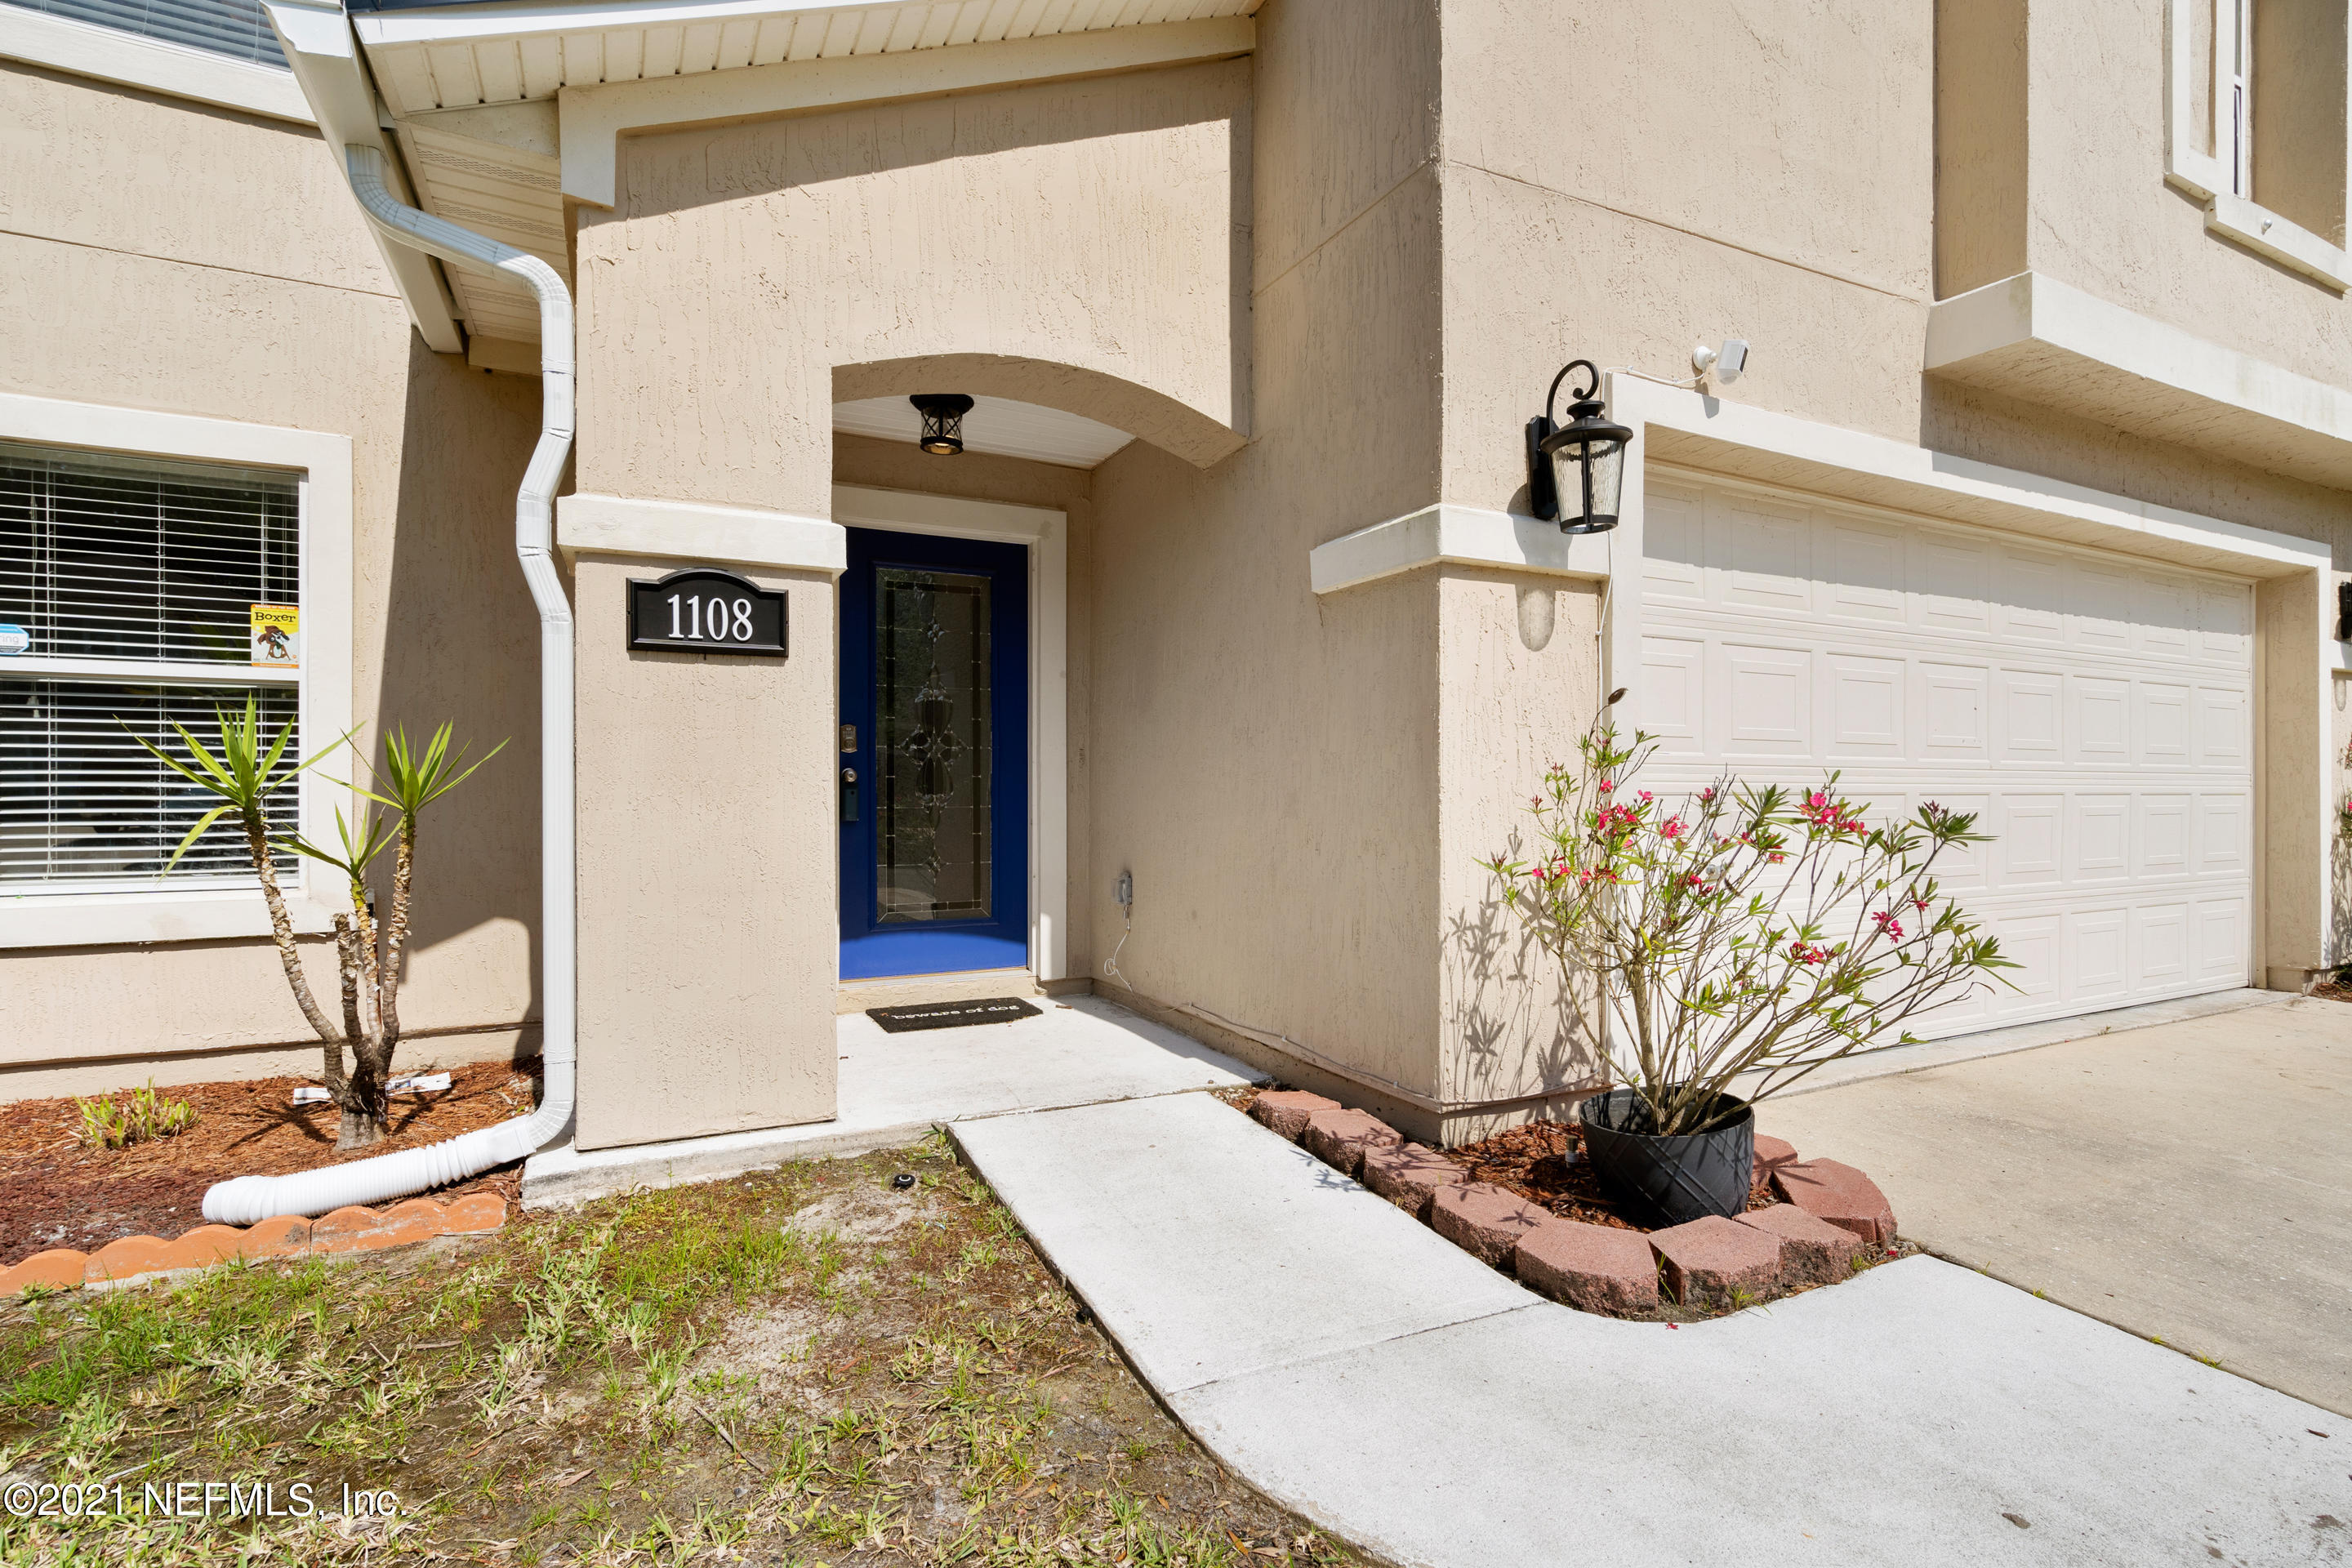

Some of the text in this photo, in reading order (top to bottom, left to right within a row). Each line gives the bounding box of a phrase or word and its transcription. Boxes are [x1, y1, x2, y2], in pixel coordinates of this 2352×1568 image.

[255, 612, 296, 622] Boxer
[667, 594, 754, 642] 1108
[0, 635, 19, 644] ing
[891, 1010, 960, 1019] beware
